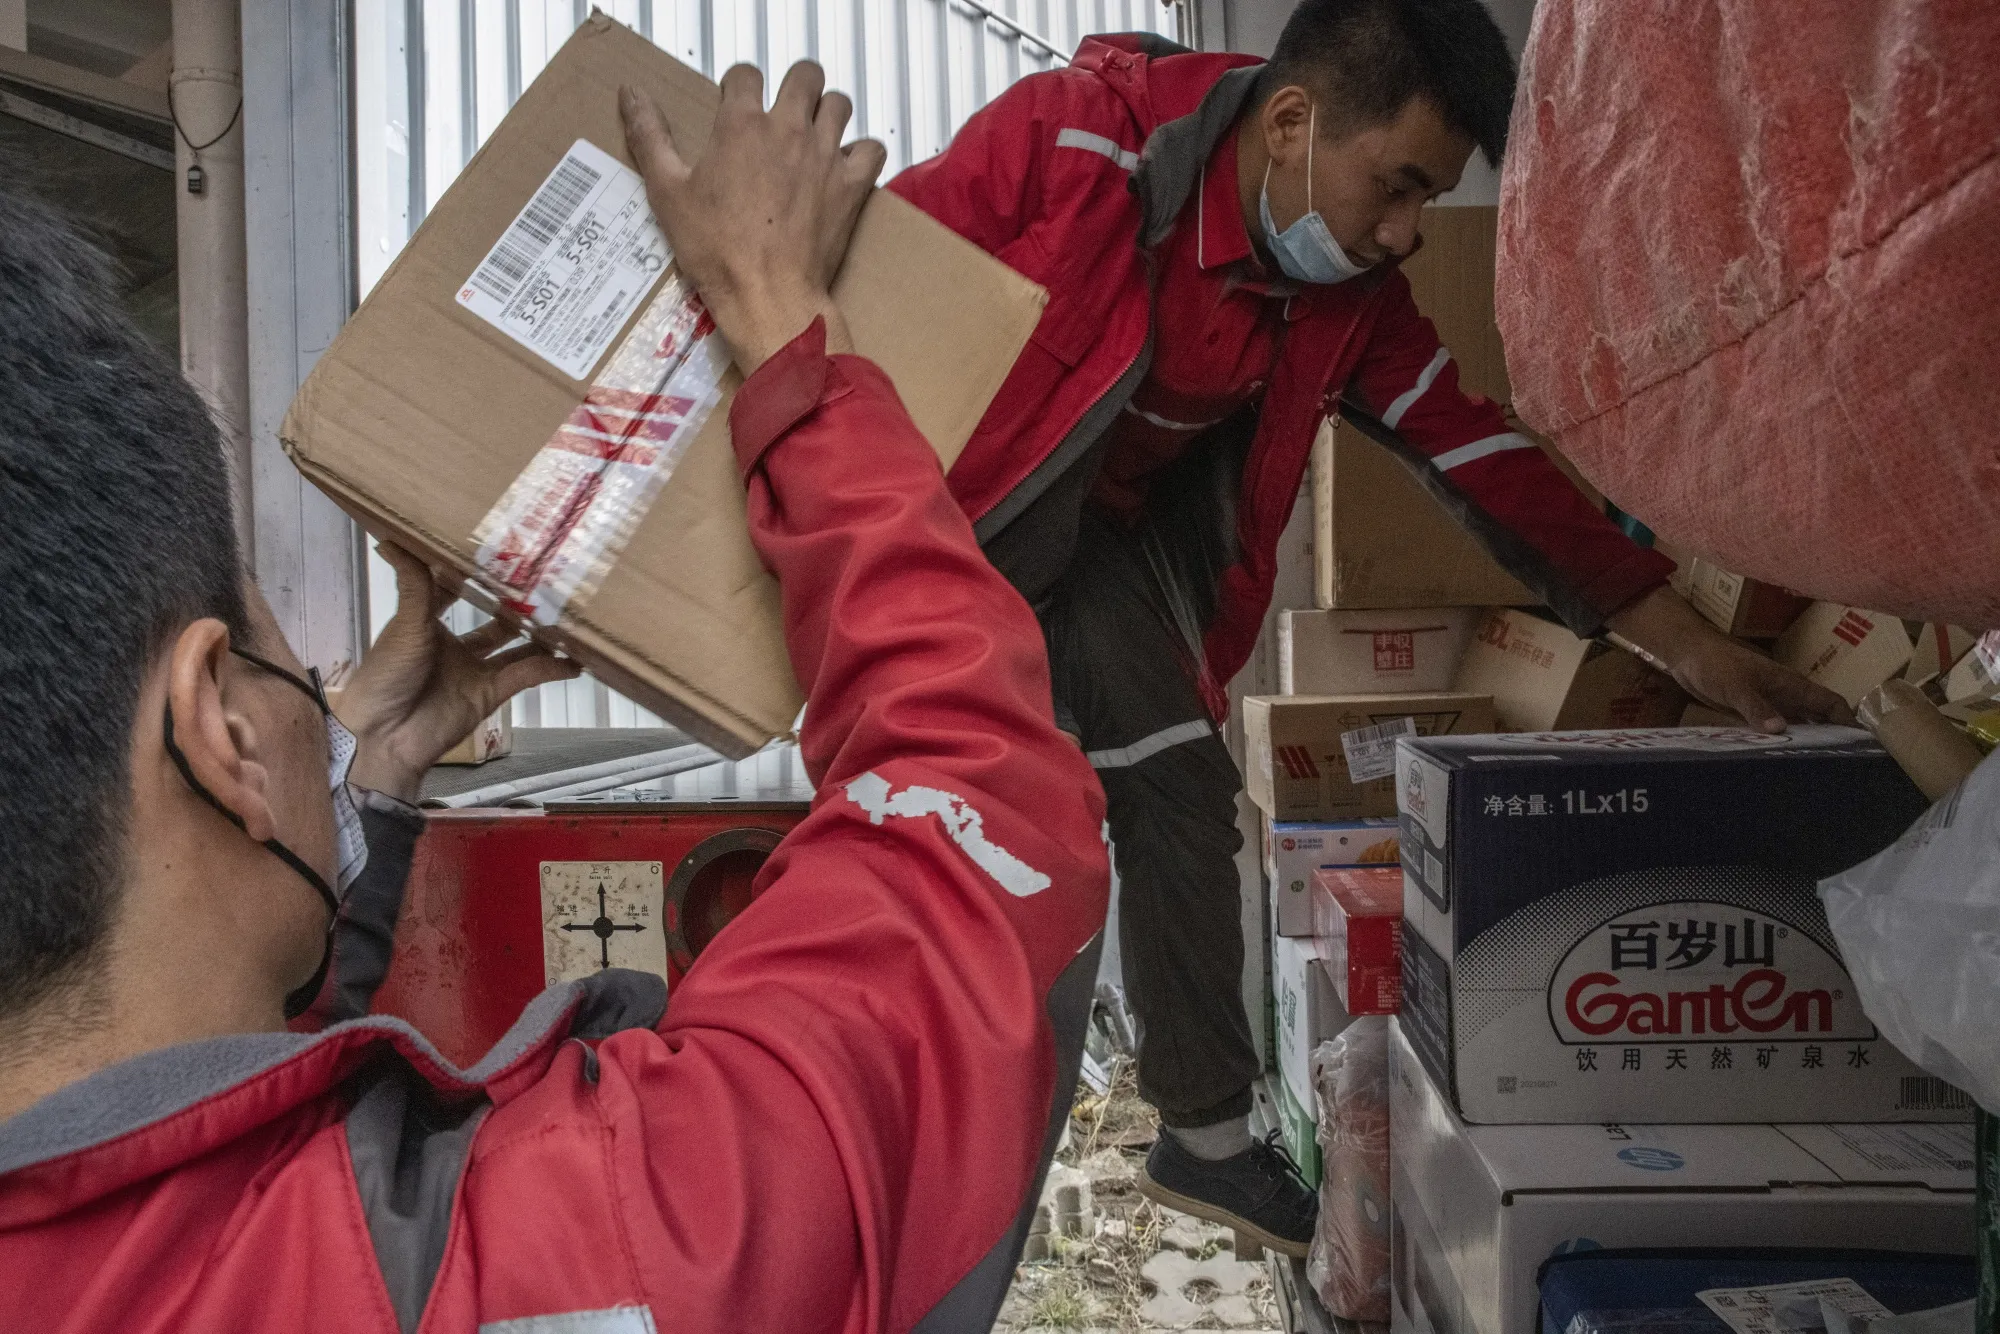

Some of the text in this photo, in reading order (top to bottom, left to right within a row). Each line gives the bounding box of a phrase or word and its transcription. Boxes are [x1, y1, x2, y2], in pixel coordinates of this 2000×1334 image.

[620, 199, 639, 220] 2/2
[566, 220, 606, 265] 5-S01
[520, 279, 561, 325] 5-S01
[1478, 615, 1511, 650] JDL
[1484, 788, 1649, 817] 净含量: 1Lx15
[1608, 918, 1775, 971] 百岁山
[1564, 968, 1834, 1036] Ganten
[1575, 1044, 1870, 1072] 饮用天然矿泉水
